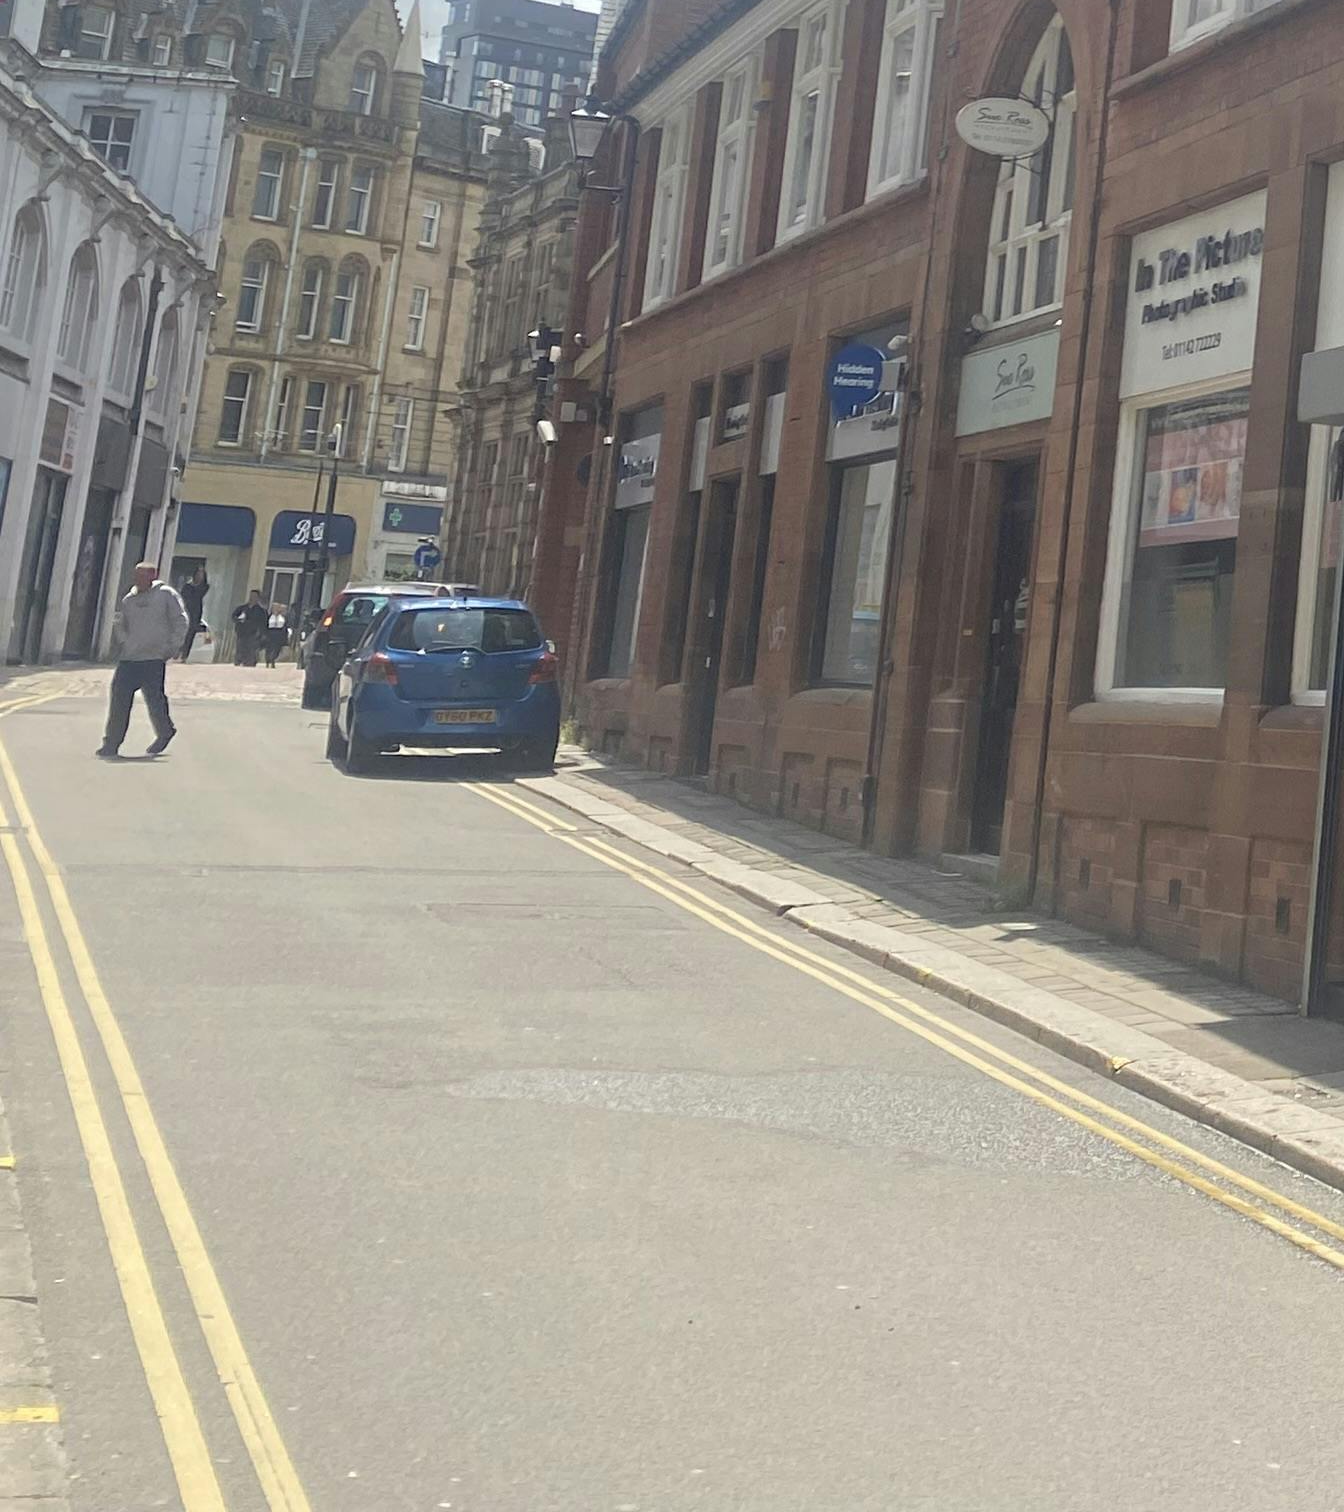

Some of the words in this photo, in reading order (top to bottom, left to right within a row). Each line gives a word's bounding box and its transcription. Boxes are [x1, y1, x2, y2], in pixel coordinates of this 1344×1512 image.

[1135, 258, 1154, 292] In
[1159, 248, 1191, 286] The
[1194, 228, 1264, 274] Picture
[1141, 288, 1209, 325] Photographic
[1211, 276, 1246, 305] Studio
[833, 376, 874, 390] Hearing
[837, 362, 874, 375] Hidden
